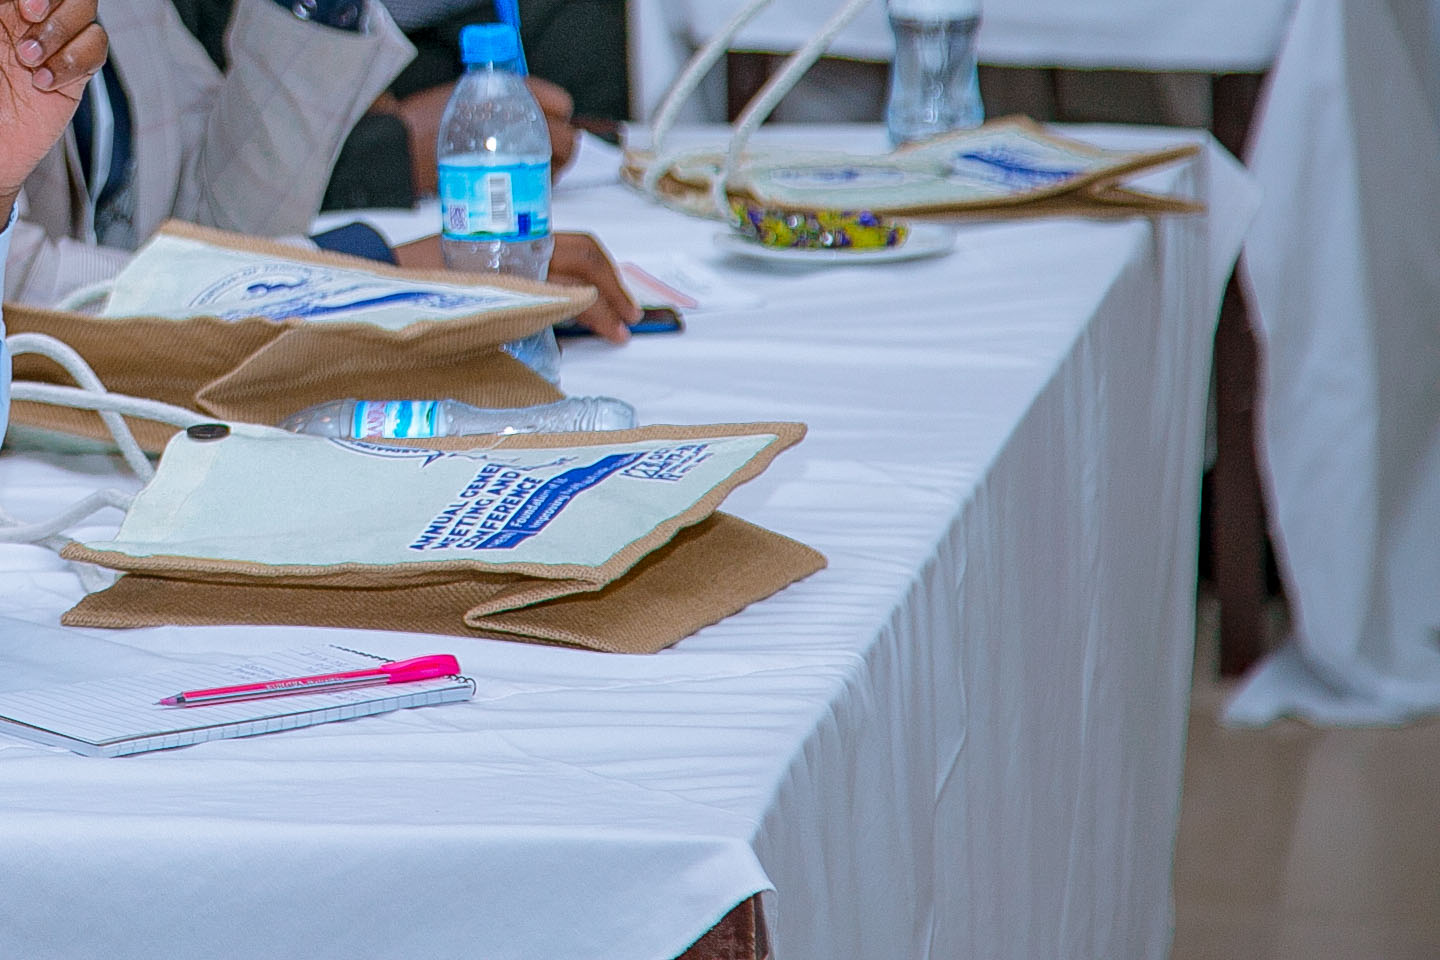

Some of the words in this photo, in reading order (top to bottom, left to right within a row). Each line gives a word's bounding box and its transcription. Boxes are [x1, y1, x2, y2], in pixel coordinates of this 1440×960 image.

[409, 501, 469, 550] ANNUAL
[431, 499, 494, 549] MEETING
[486, 471, 520, 496] AND
[456, 476, 543, 548] CONFERENCE
[510, 489, 552, 528] Foundation
